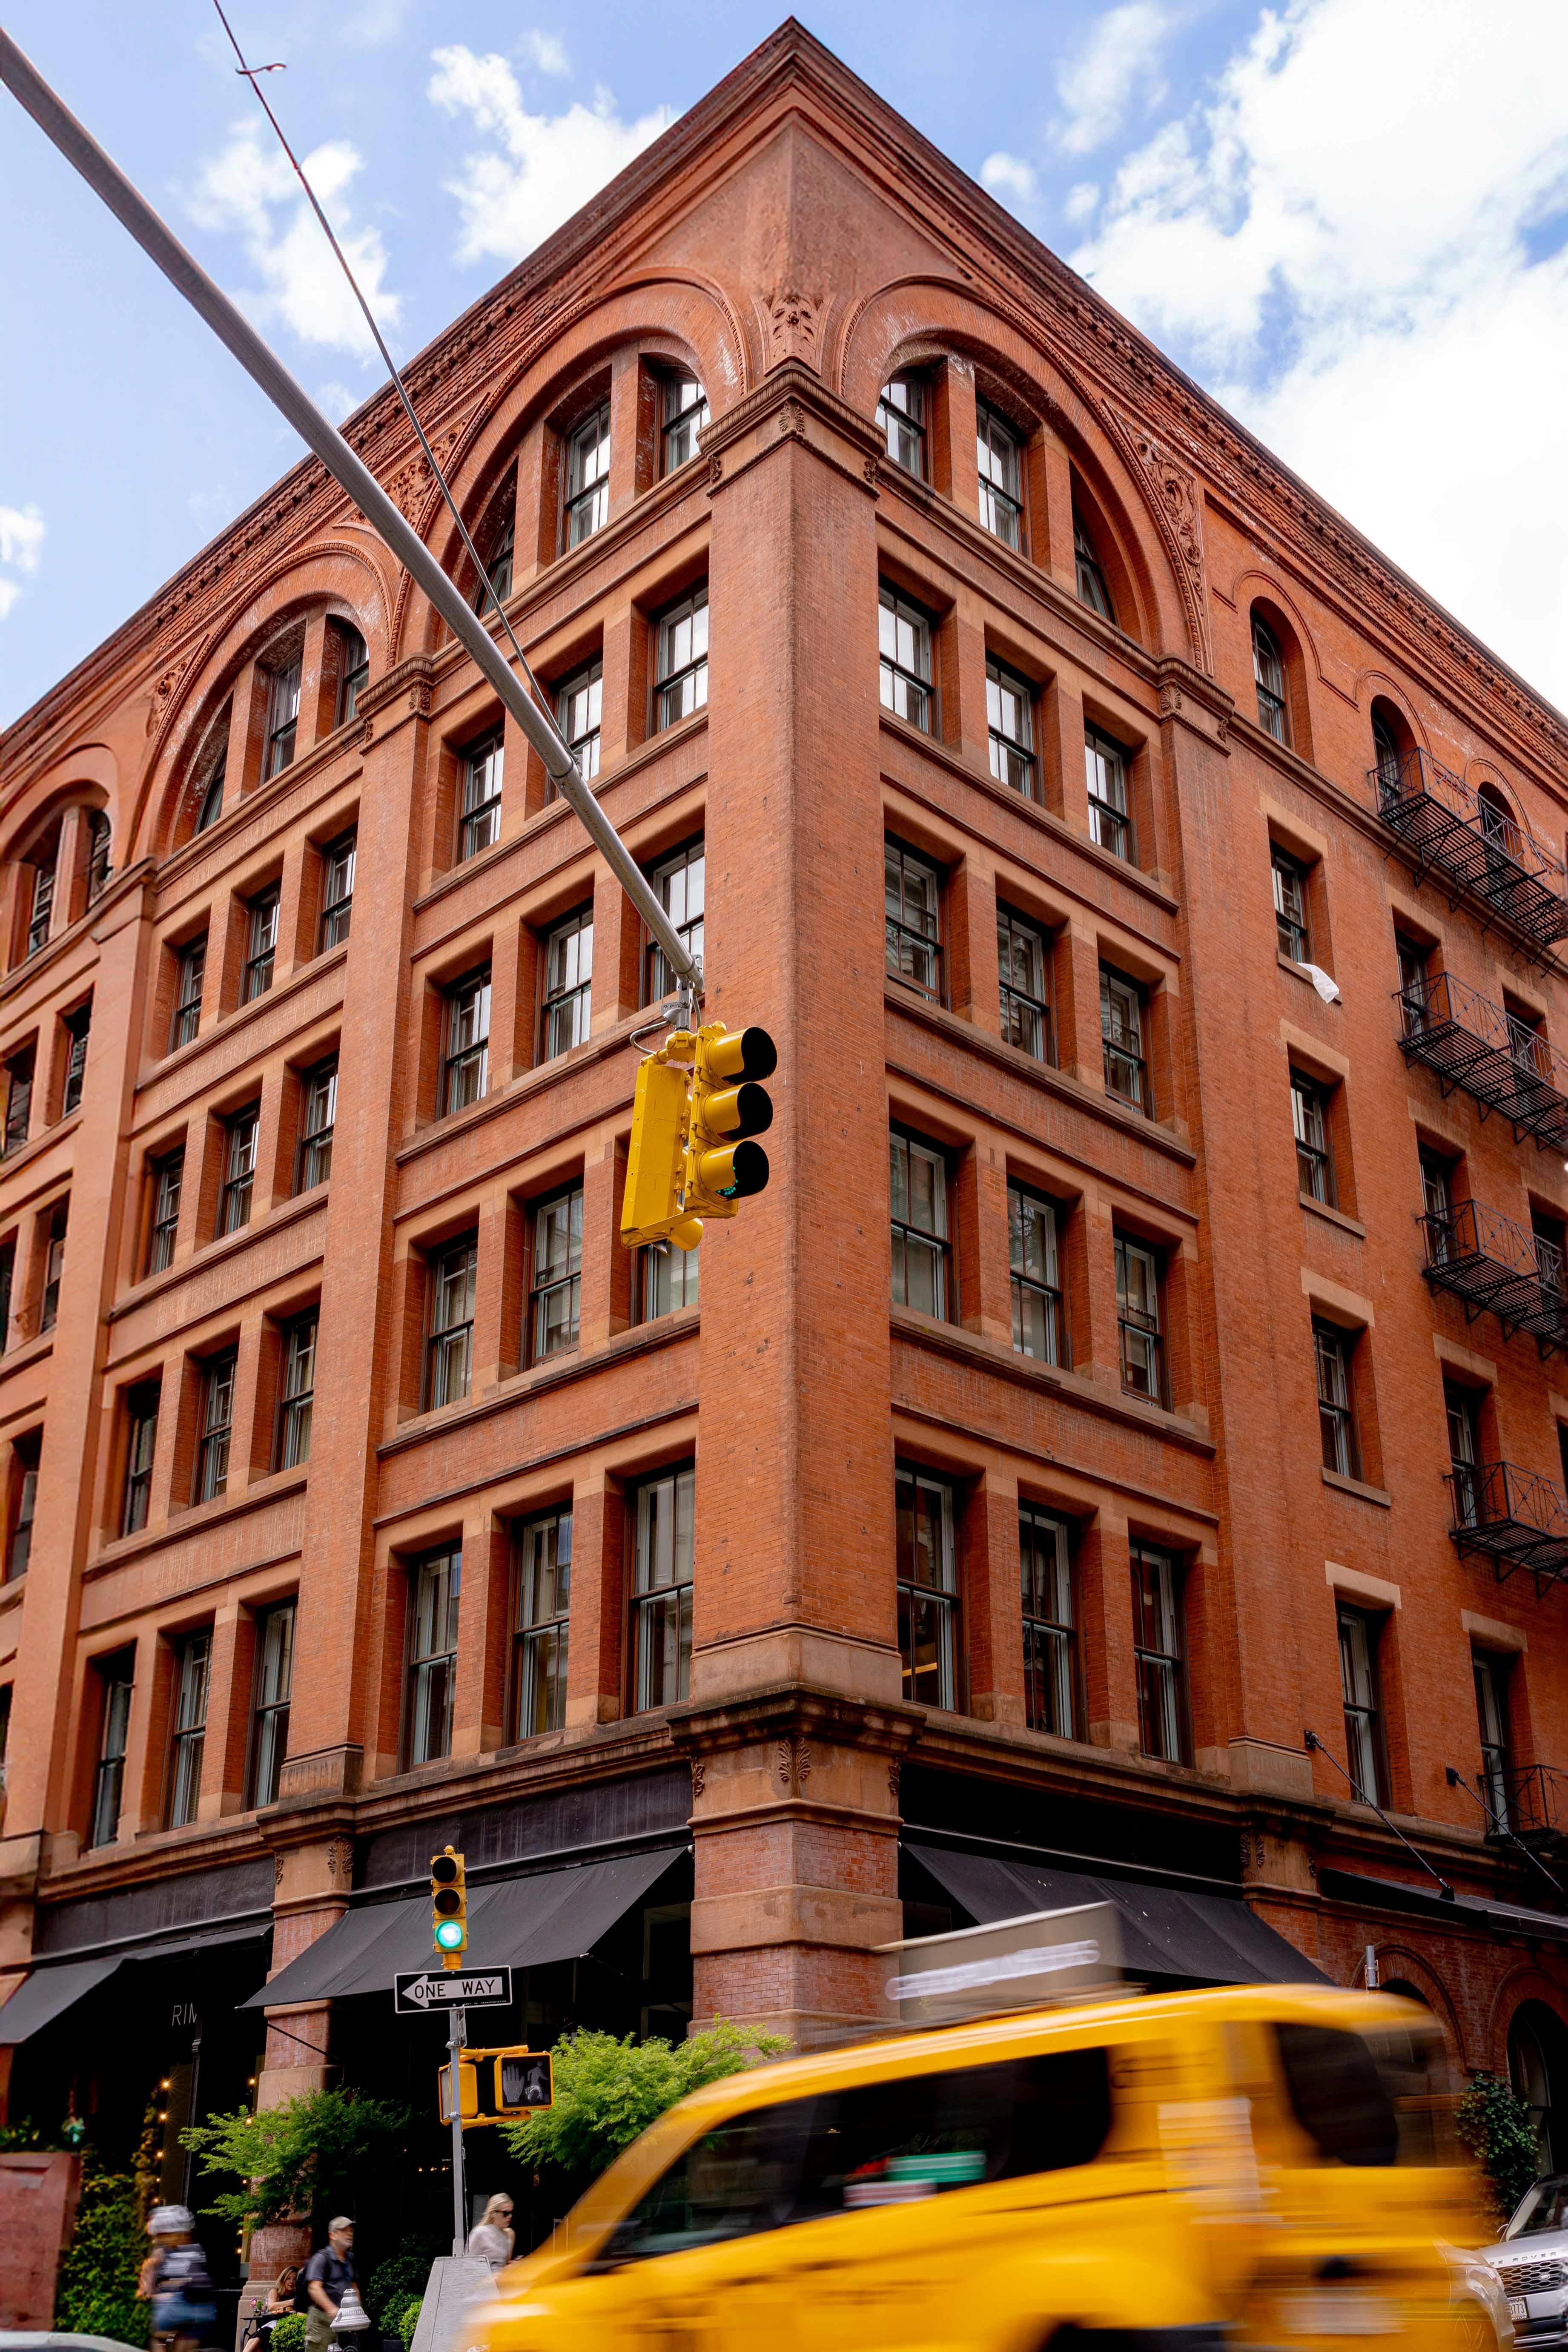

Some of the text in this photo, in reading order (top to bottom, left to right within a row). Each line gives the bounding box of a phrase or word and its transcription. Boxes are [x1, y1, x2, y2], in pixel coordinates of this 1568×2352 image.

[415, 1979, 495, 1999] ONE WAY
[1513, 2252, 1556, 2262] ROVER
